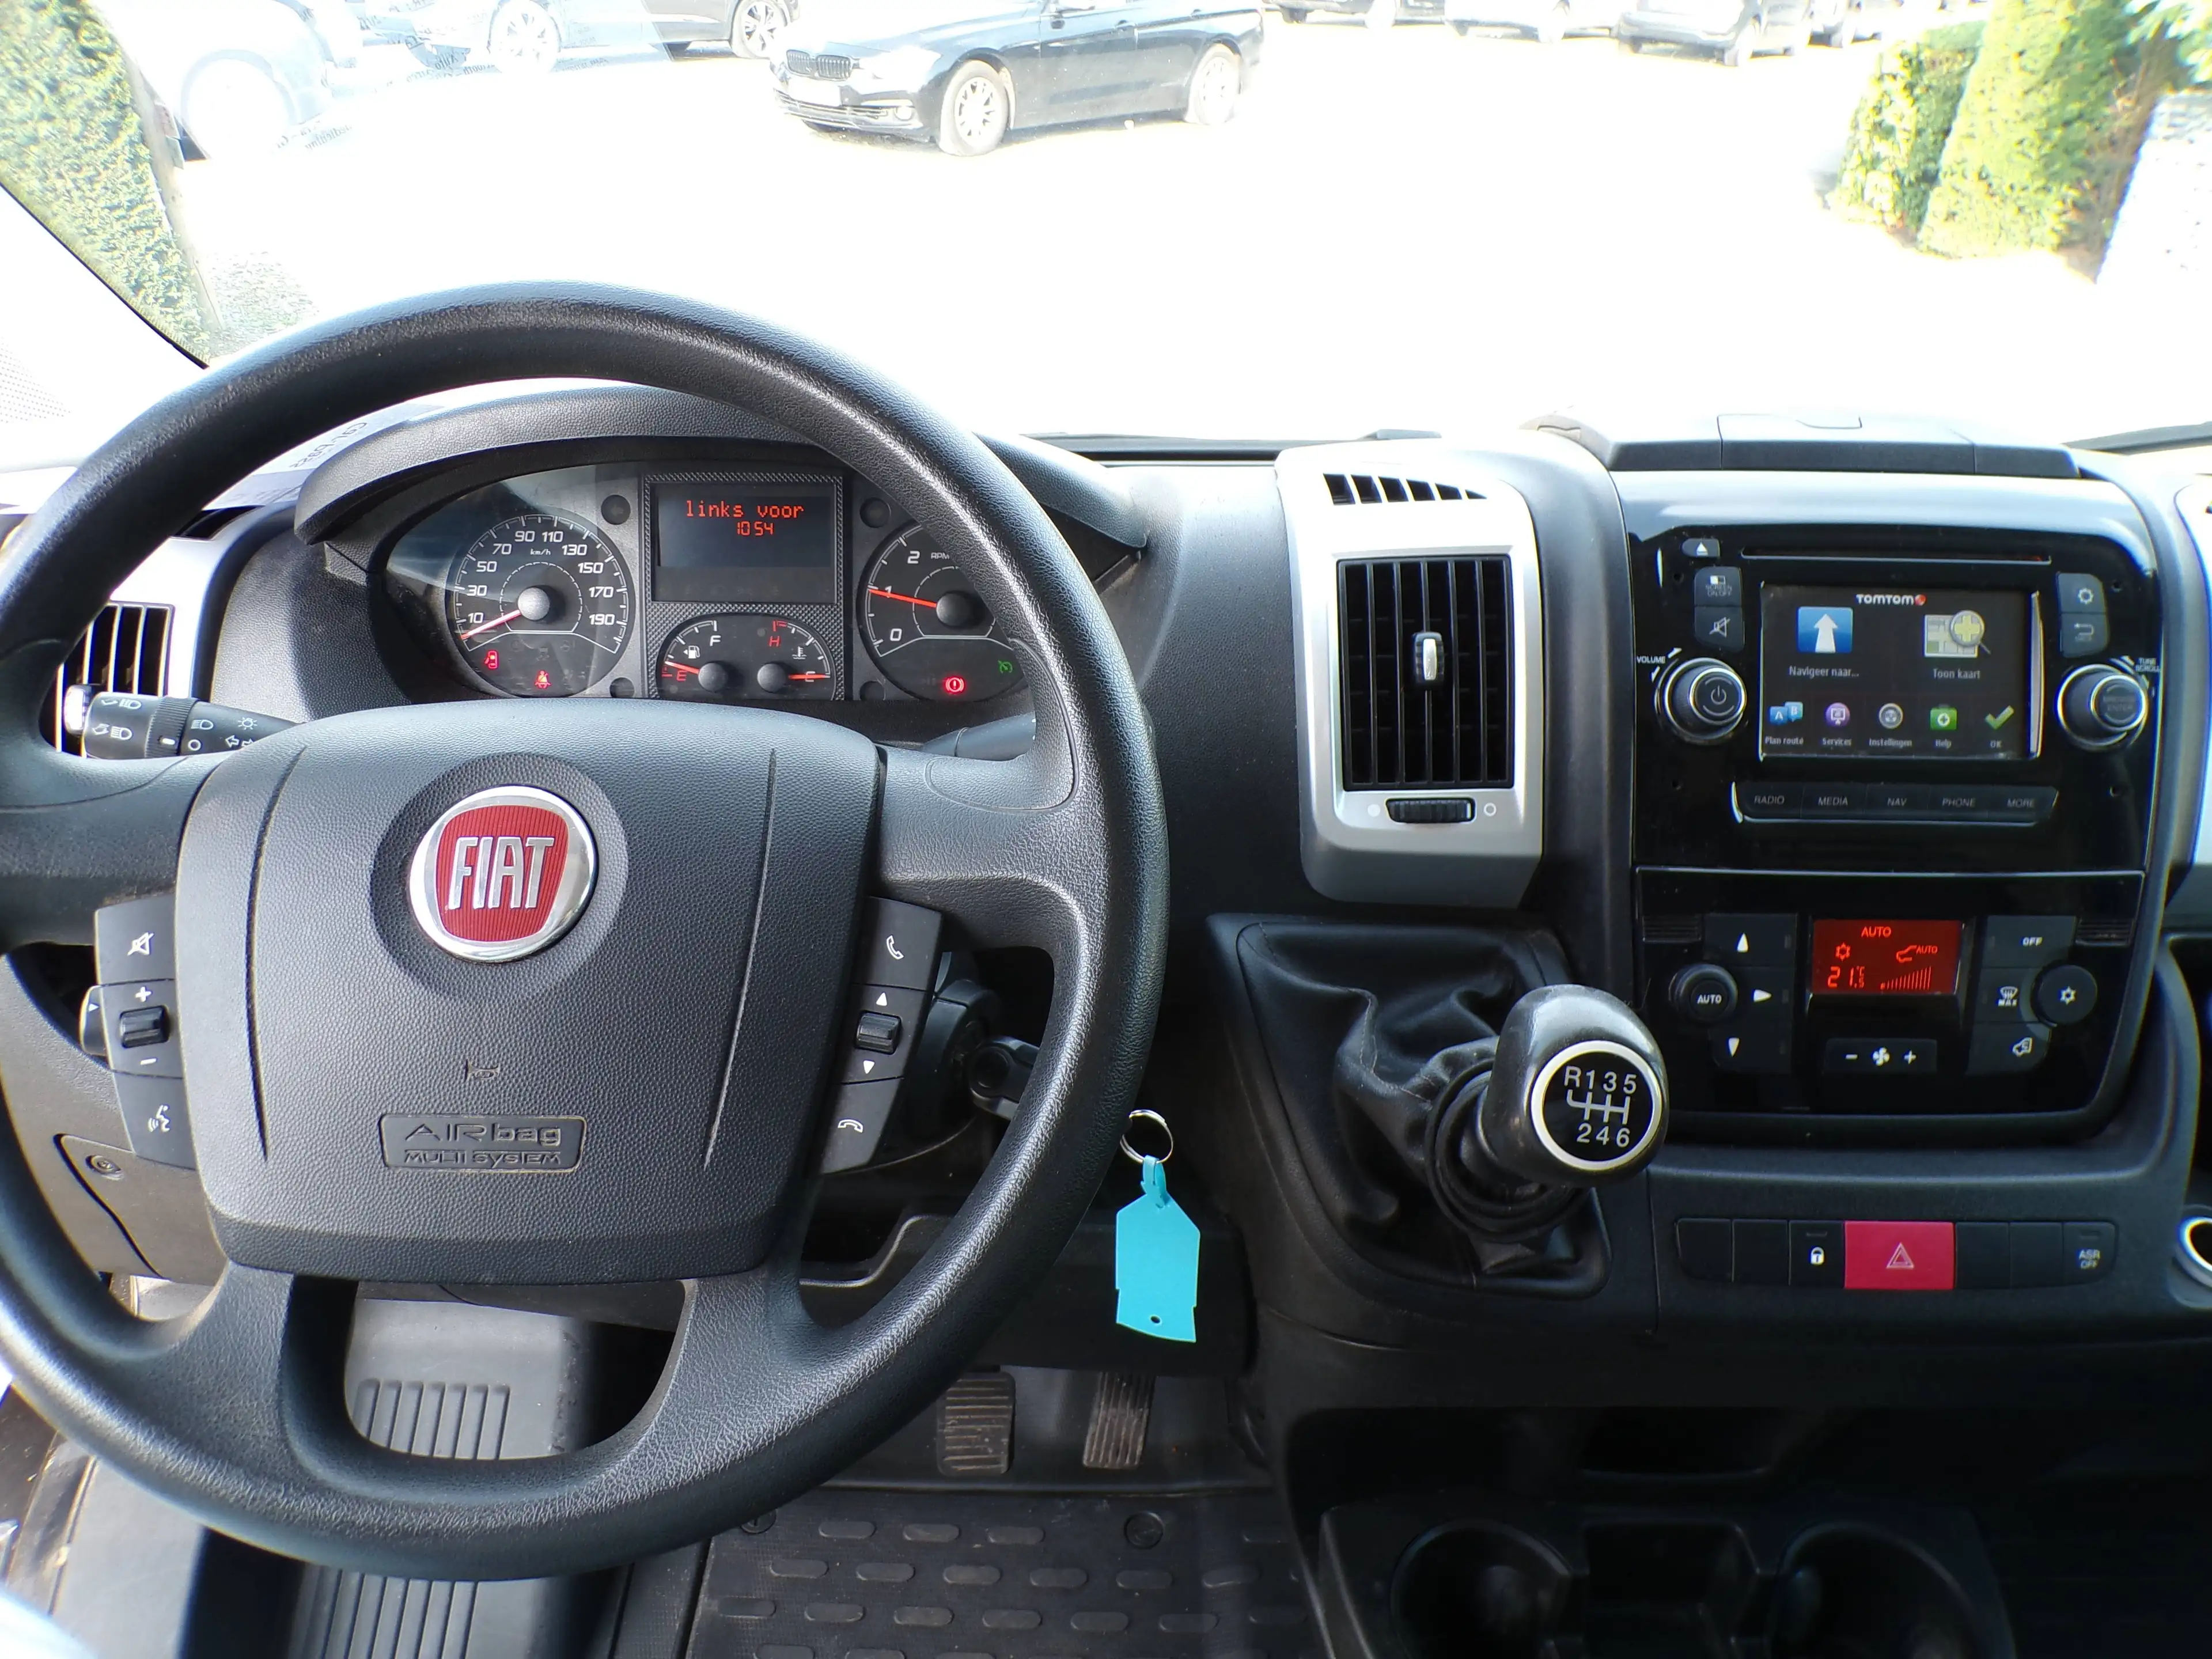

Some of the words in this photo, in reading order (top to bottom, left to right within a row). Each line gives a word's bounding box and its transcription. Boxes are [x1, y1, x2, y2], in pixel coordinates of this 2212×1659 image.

[685, 500, 744, 518] links
[757, 504, 805, 518] voor
[515, 531, 535, 542] 90
[542, 531, 563, 542] 110
[493, 543, 512, 555] 70
[562, 544, 588, 556] 130
[907, 551, 920, 564] 2
[930, 552, 950, 560] RPM
[476, 561, 497, 572] 50
[578, 562, 603, 574] 150
[467, 585, 487, 596] 30
[589, 586, 613, 598] 170
[467, 612, 484, 623] 10
[589, 614, 615, 626] 190
[890, 628, 902, 641] 0
[710, 635, 721, 646] F
[769, 636, 781, 647] H
[1637, 656, 1666, 664] VOLUME
[677, 670, 687, 681] E
[1789, 665, 1829, 679] Navigeer
[1933, 668, 1955, 679] Toon
[1957, 668, 1980, 679] kaart
[1765, 736, 1781, 745] Plan
[1822, 737, 1851, 746] Services
[1869, 738, 1912, 748] Instellingen
[1936, 739, 1952, 748] Help
[1754, 795, 1785, 805] RADIO
[1818, 797, 1848, 806] MEDIA
[1887, 797, 1907, 806] NAV
[1942, 797, 1976, 807] PHONE
[2007, 798, 2035, 808] MORE
[448, 836, 555, 910] FIAT
[1861, 926, 1891, 938] AUTO
[2022, 937, 2043, 947] OFF
[1916, 945, 1938, 955] AUTO
[1698, 994, 1722, 1004] AUTO
[1564, 1066, 1582, 1088] R
[1586, 1070, 1595, 1089] 1
[1603, 1071, 1617, 1092] 3
[1623, 1074, 1637, 1094] 5
[1577, 1123, 1592, 1143] 2
[1596, 1126, 1609, 1145] 4
[1616, 1128, 1630, 1147] 6
[2079, 1249, 2100, 1260] ASR
[2081, 1259, 2098, 1270] OFF
